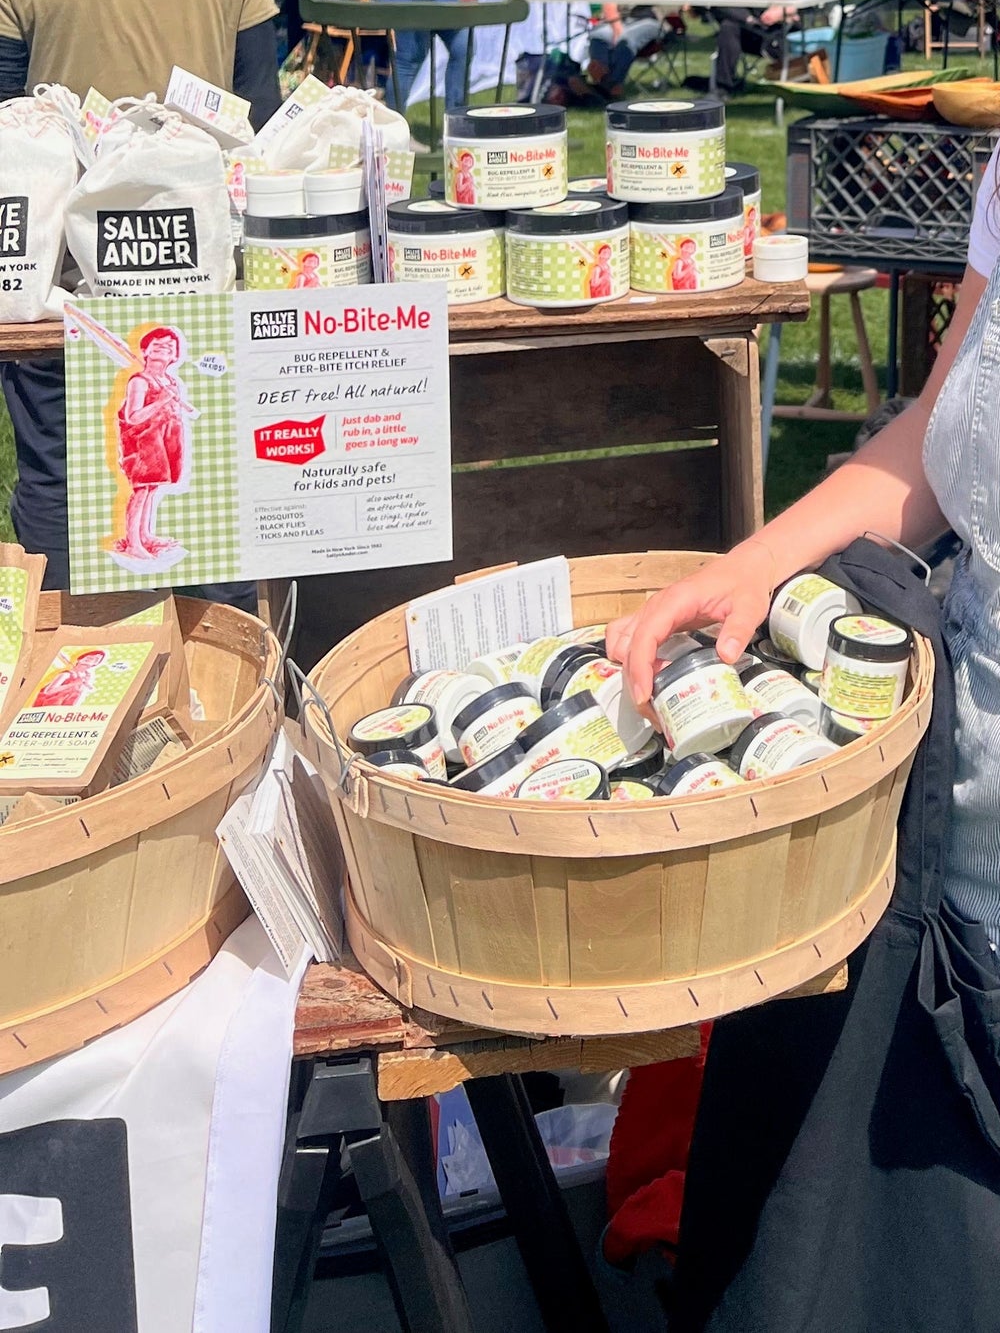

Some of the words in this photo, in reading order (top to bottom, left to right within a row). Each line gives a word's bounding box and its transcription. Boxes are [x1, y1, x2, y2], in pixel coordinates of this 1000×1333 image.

[510, 148, 556, 163] No-Bite-Me
[638, 147, 689, 158] No-Bite-Me
[103, 215, 189, 240] SALLYE
[103, 240, 192, 266] ANDER
[423, 247, 477, 261] No-Bite-Me
[9, 263, 37, 271] YORK
[0, 278, 23, 291] 82
[145, 278, 156, 286] IN
[159, 277, 180, 285] NEW
[184, 274, 211, 283] YORK
[253, 311, 295, 326] SALLYE
[304, 305, 431, 336] No-Bite-Me
[253, 324, 296, 338] ANDER
[294, 352, 317, 363] BUG
[318, 349, 379, 362] REPELLENT
[381, 348, 390, 357] &
[279, 363, 343, 375] AFTER-BITE
[345, 360, 369, 371] ITCH
[371, 358, 407, 369] RELIEF
[257, 389, 301, 405] DEET
[304, 384, 341, 404] free!
[344, 383, 367, 400] All
[370, 377, 428, 397] natural!
[342, 416, 361, 427] Just
[363, 414, 381, 424] dab
[383, 412, 401, 422] and
[259, 429, 272, 441] IT
[274, 426, 320, 440] REALLY
[343, 427, 359, 437] rub
[382, 424, 406, 434] little
[266, 443, 315, 457] WORKS!
[345, 439, 368, 451] goes
[377, 436, 398, 449] long
[400, 435, 419, 447] way
[302, 464, 359, 479] Naturally
[361, 462, 387, 474] safe
[294, 480, 312, 491] for
[314, 478, 339, 490] kids
[341, 476, 363, 487] and
[366, 473, 396, 488] pets!
[260, 512, 304, 521] MOSQUITOS
[260, 523, 284, 531] BLACK
[285, 521, 306, 529] FLIES
[260, 532, 282, 540] TICKS
[283, 530, 300, 538] AND
[301, 528, 324, 536] FLEAS
[45, 712, 109, 723] No-Bite-Me
